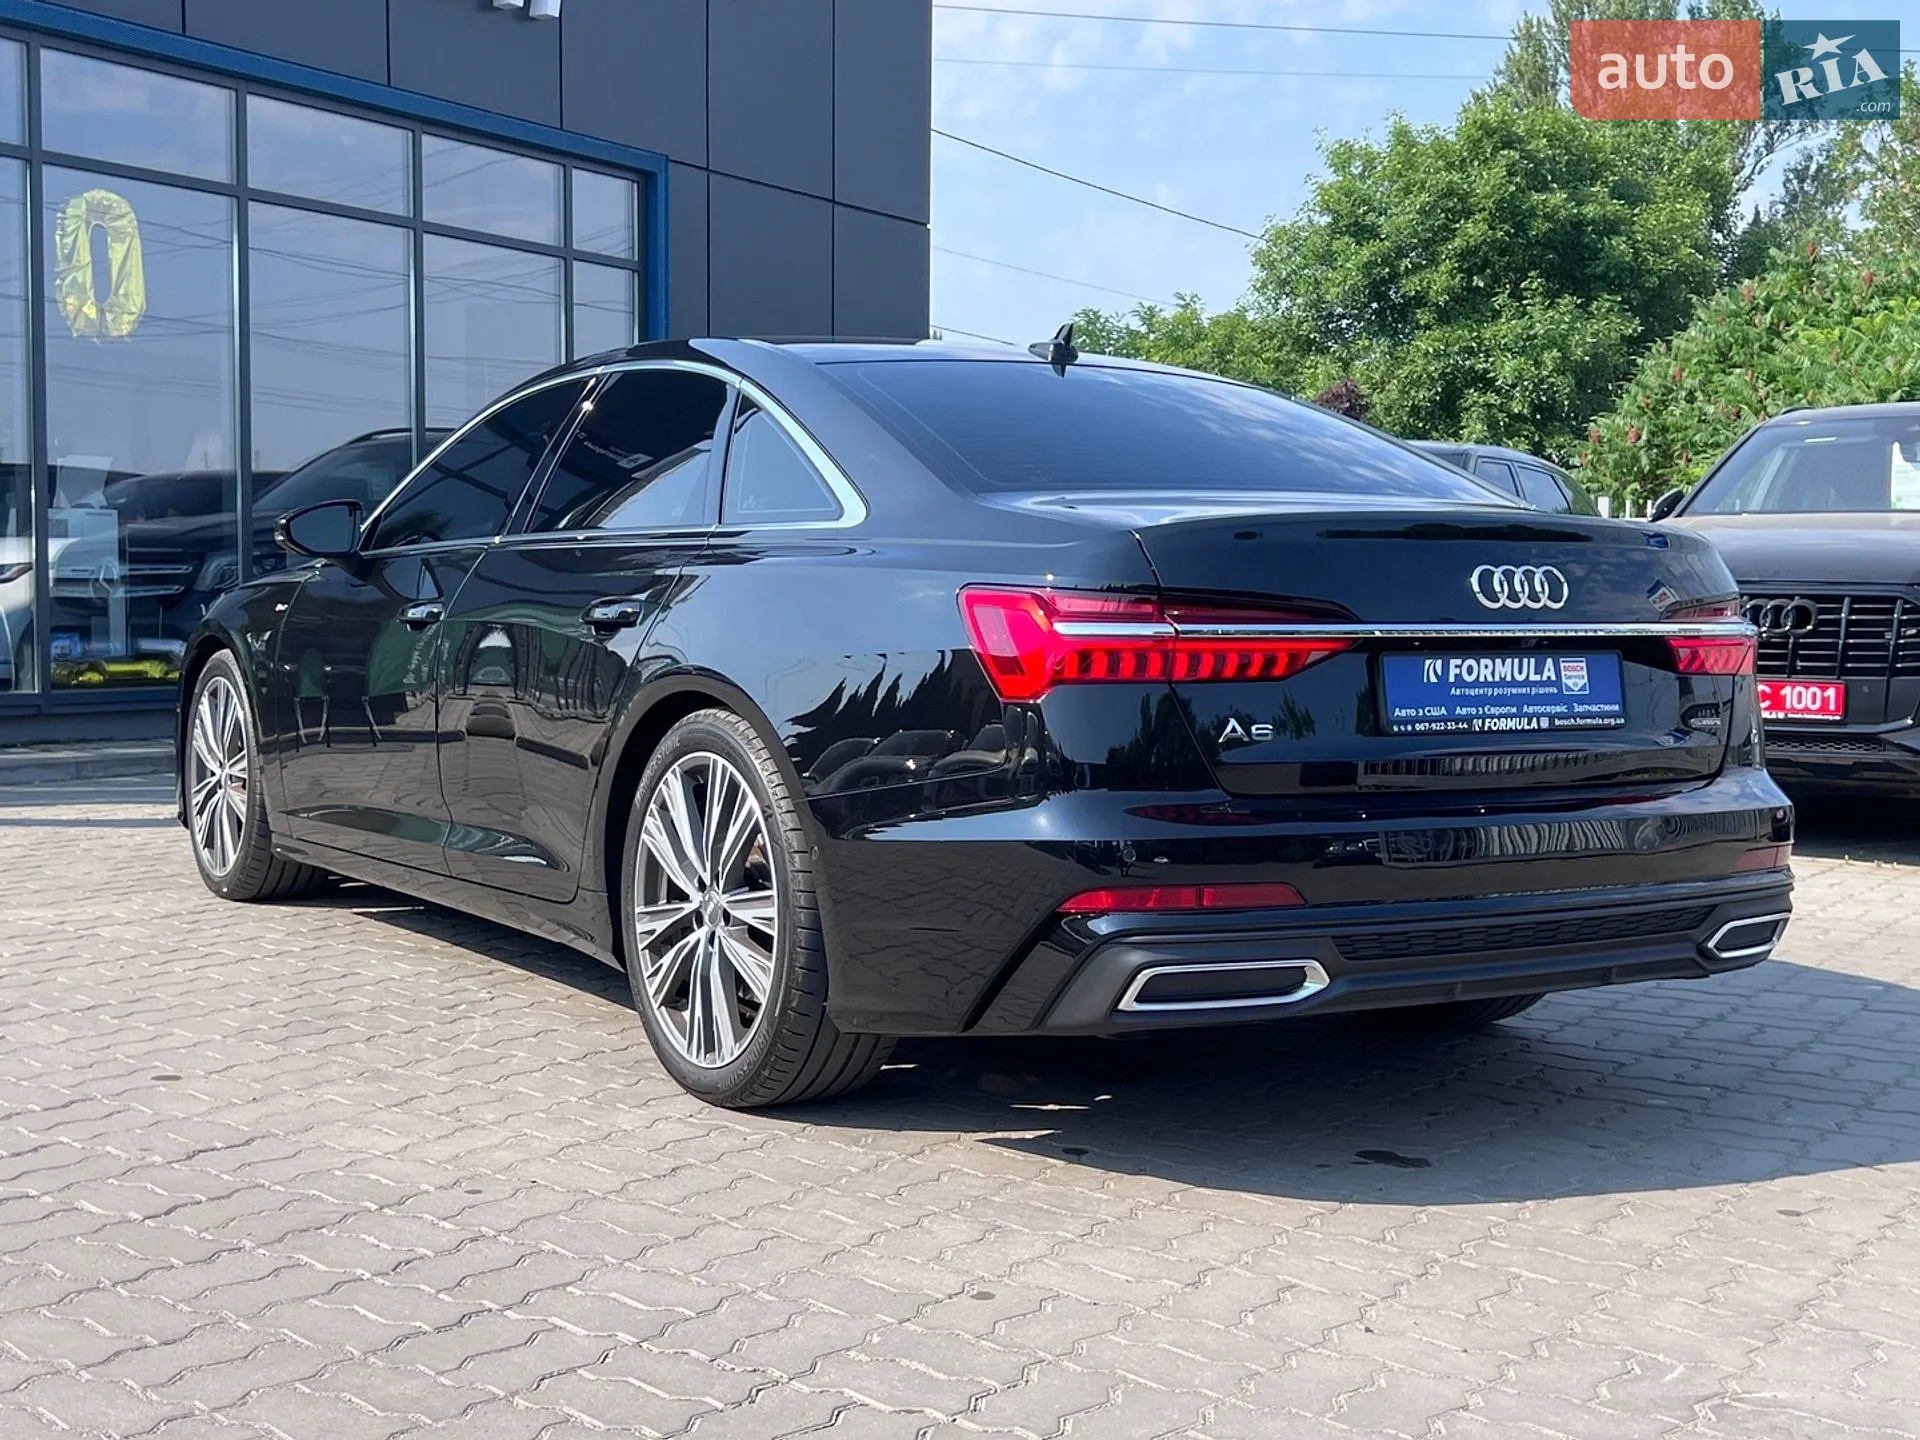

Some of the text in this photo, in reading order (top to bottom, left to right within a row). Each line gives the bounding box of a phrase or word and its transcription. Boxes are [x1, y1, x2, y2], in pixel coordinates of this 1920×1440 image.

[1448, 658, 1557, 683] FORMULA
[1563, 664, 1584, 672] BOSCH
[1450, 686, 1493, 697] Автоцентр
[1780, 685, 1836, 711] 1001
[1394, 706, 1417, 718] Авто
[1424, 706, 1447, 717] США
[1455, 705, 1477, 716] Авто
[1218, 717, 1274, 743] A6
[1484, 717, 1538, 731] FORMULA
